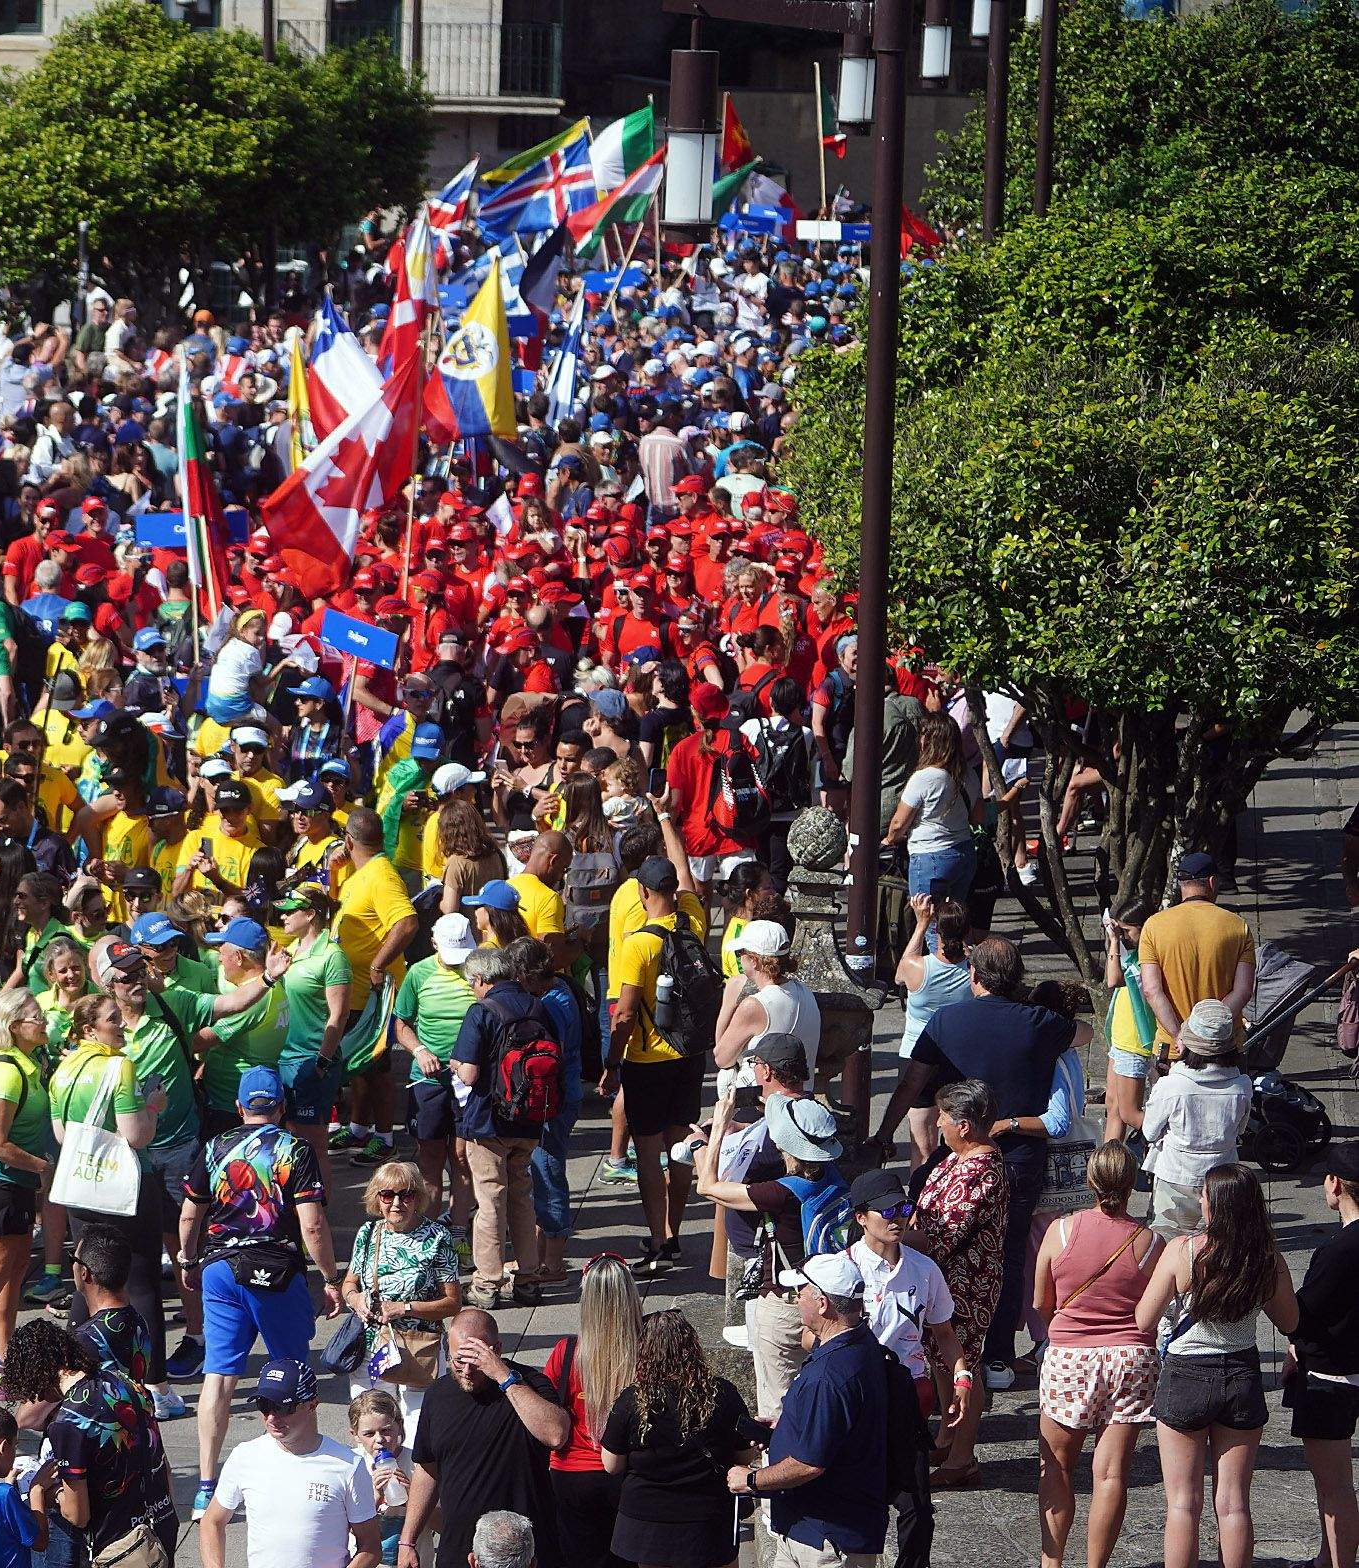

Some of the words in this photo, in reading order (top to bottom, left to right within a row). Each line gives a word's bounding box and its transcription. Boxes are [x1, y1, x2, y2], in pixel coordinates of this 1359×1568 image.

[73, 1167, 104, 1183] AUS
[1041, 1195, 1074, 1205] ONDON
[310, 1482, 330, 1491] TYPE
[309, 1488, 329, 1497] TWO
[308, 1494, 329, 1502] FUN
